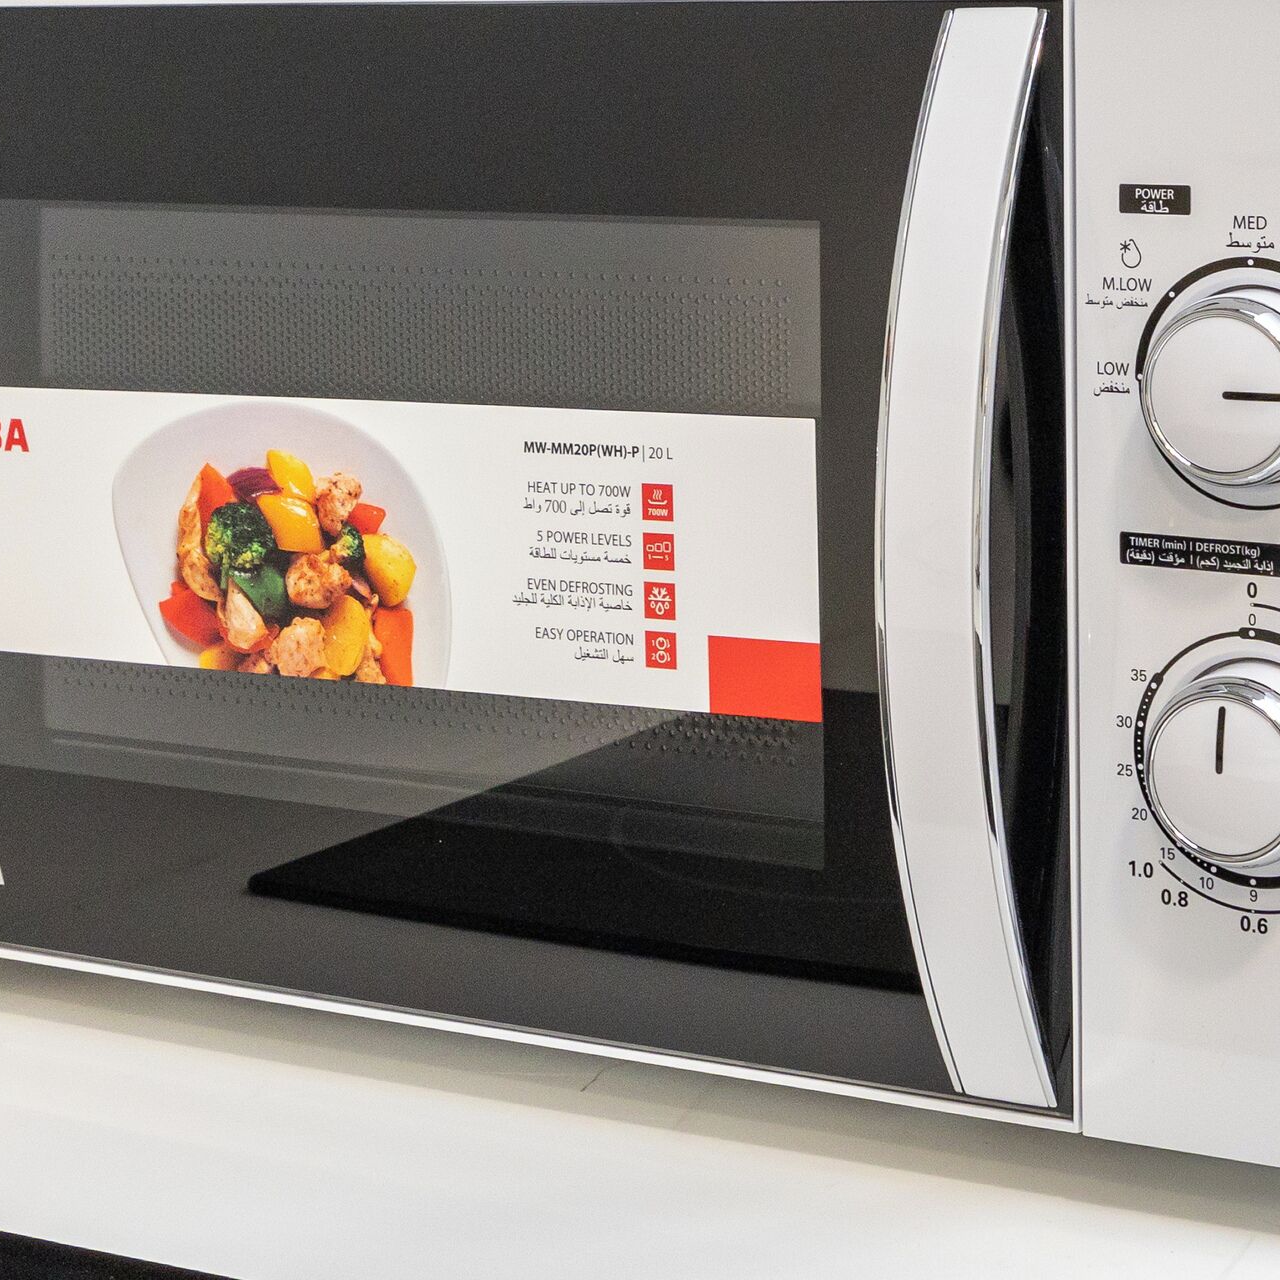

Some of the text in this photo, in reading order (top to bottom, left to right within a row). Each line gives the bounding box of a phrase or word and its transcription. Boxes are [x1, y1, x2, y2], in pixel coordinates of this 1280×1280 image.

[1135, 188, 1174, 200] POWER
[1140, 200, 1169, 213] طاقة
[1233, 215, 1267, 230] MED
[1225, 232, 1275, 253] متوسط
[1102, 277, 1152, 292] M.LOW
[1085, 293, 1148, 309] منخفض متوسط
[1097, 362, 1129, 376] LOW
[1093, 380, 1130, 396] منخفض
[523, 441, 639, 459] MW-MM20P(WH)-P
[648, 447, 663, 459] 20
[667, 448, 673, 460] L
[527, 481, 631, 498] HEAT UP TO 700W
[545, 499, 567, 513] 700
[647, 507, 668, 517] 700W
[537, 530, 632, 547] 5 POWER LEVELS
[1129, 536, 1160, 548] TIMER
[1162, 539, 1187, 551] (min)
[527, 578, 633, 596] EVEN DEFROSTING
[1247, 582, 1258, 598] 0
[1248, 614, 1256, 625] 0
[535, 627, 634, 645] EASY OPERATION
[1131, 669, 1147, 682] 35
[1116, 716, 1133, 728] 30
[1117, 764, 1133, 777] 25
[1132, 808, 1147, 820] 20
[1160, 848, 1175, 860] 15
[1128, 861, 1153, 878] 1.0
[1200, 877, 1214, 889] 10
[1161, 889, 1188, 907] 0.8
[1250, 890, 1257, 902] 9
[1240, 916, 1268, 934] 0.6
